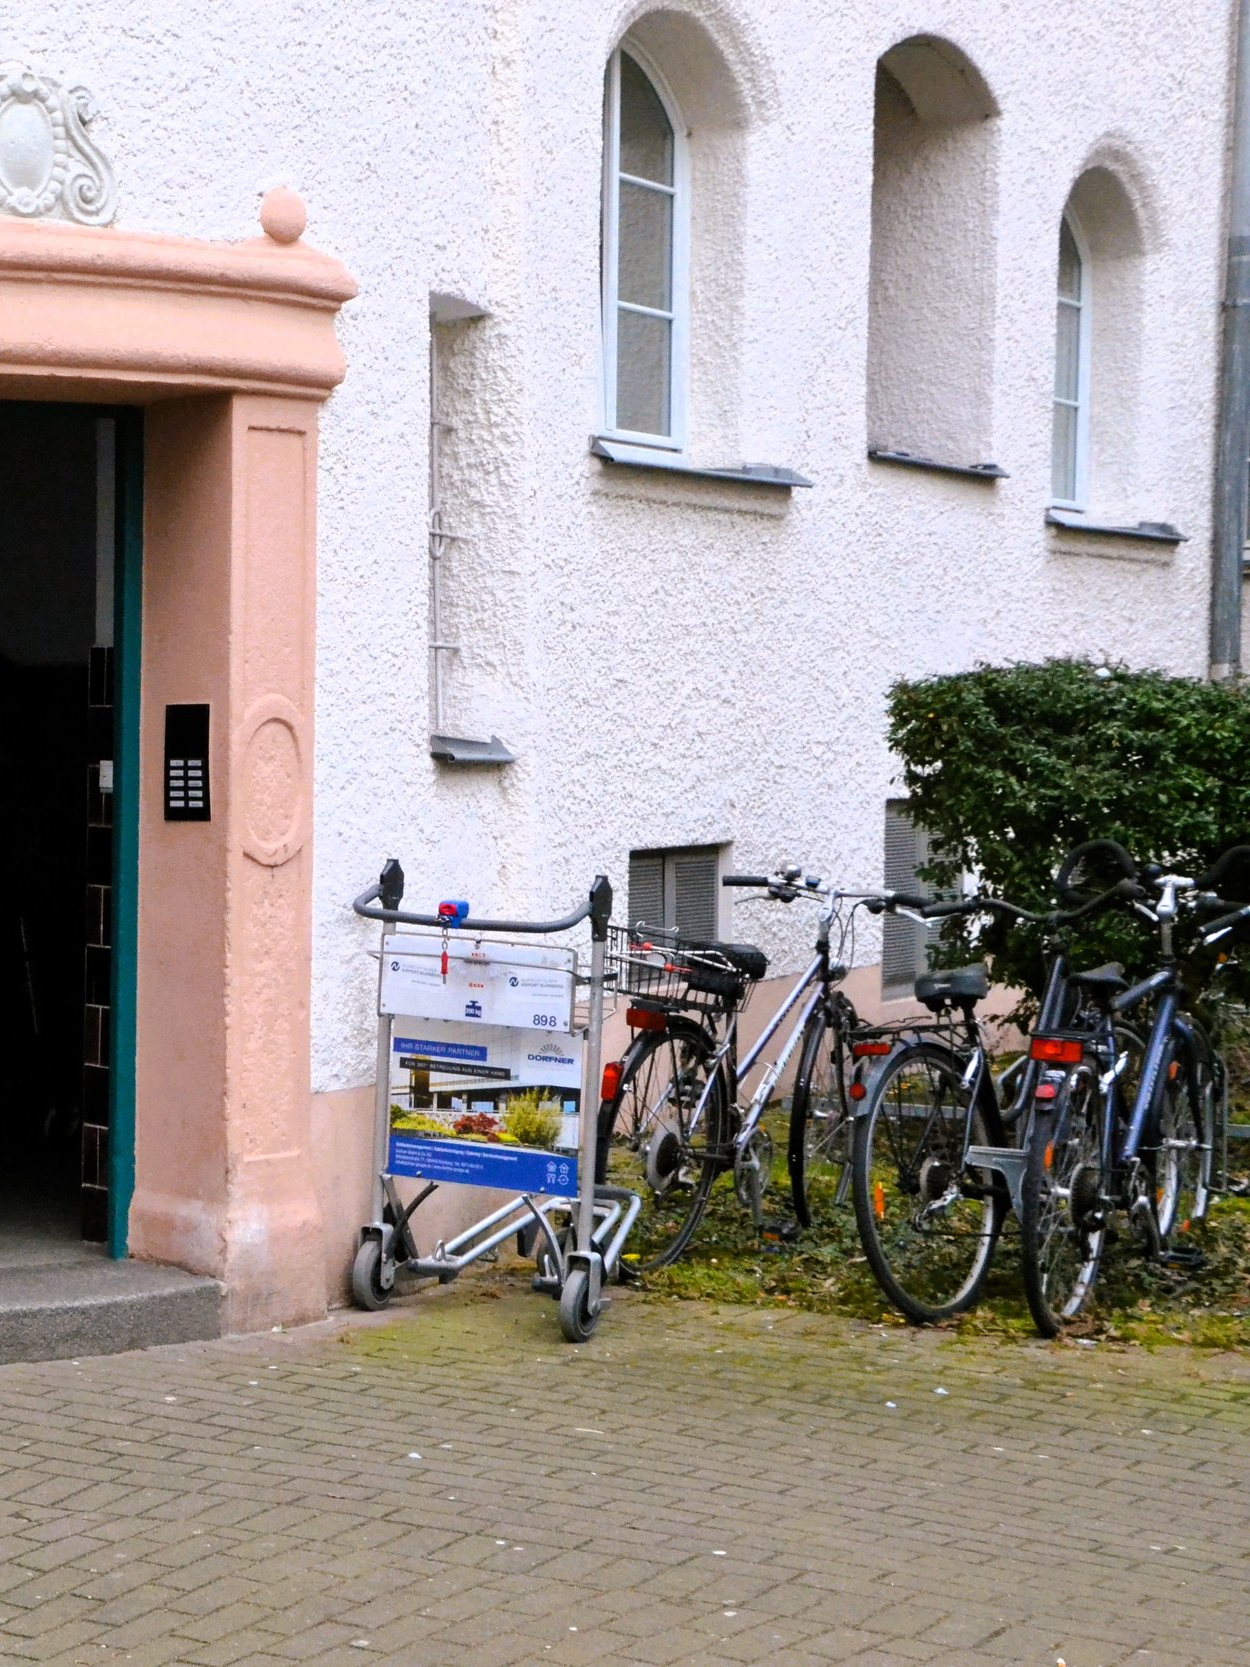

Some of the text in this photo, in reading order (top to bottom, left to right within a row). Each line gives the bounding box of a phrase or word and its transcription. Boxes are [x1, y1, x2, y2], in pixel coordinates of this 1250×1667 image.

[532, 1014, 557, 1027] 898
[414, 1043, 446, 1053] STARKER
[447, 1048, 481, 1057] PARTNER
[527, 1053, 575, 1065] DORFNER
